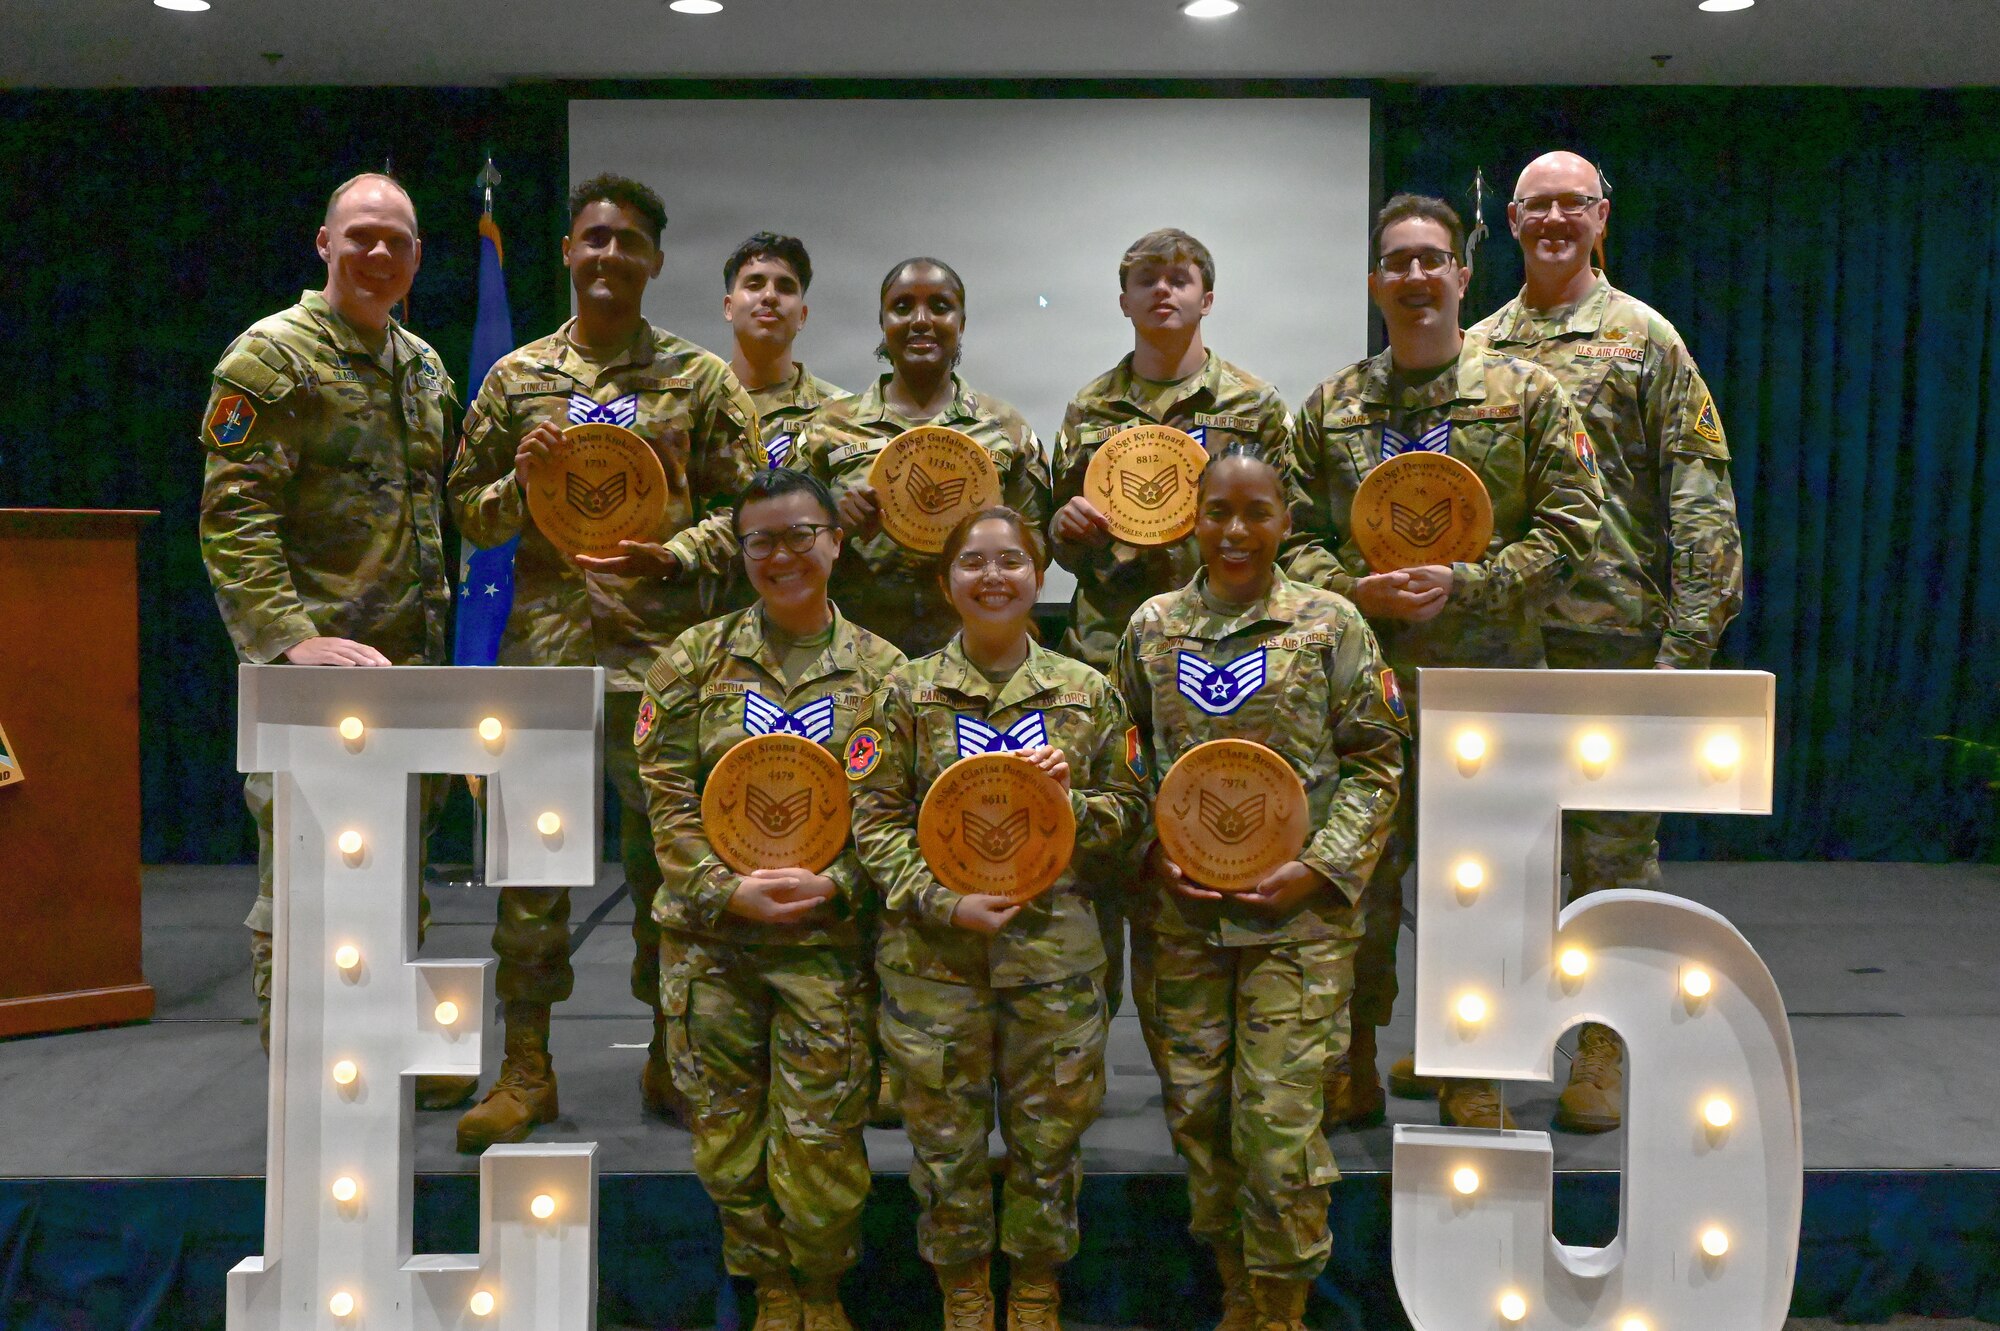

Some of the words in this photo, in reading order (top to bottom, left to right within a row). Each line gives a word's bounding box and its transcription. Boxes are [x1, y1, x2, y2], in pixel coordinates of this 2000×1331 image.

[1577, 345, 1594, 356] U.S.
[1596, 347, 1612, 357] AIR
[1613, 348, 1644, 360] FORCE
[520, 380, 558, 392] KINKELA
[663, 378, 692, 388] FORCE
[1489, 407, 1520, 418] FORCE
[1228, 415, 1255, 429] FORCE
[1341, 415, 1369, 426] SHARP
[843, 441, 869, 457] COLIN
[1104, 437, 1132, 461] (S)Sgt
[1132, 430, 1156, 442] Kyle
[1157, 431, 1186, 449] Roark
[969, 450, 989, 476] Colin
[1135, 454, 1160, 465] 8812
[1112, 521, 1144, 538] ANGELES
[1143, 530, 1158, 538] AIR
[1282, 638, 1298, 648] AIR
[1300, 634, 1334, 646] FORCE
[1058, 692, 1088, 705] FORCE
[1250, 752, 1285, 780] Brown
